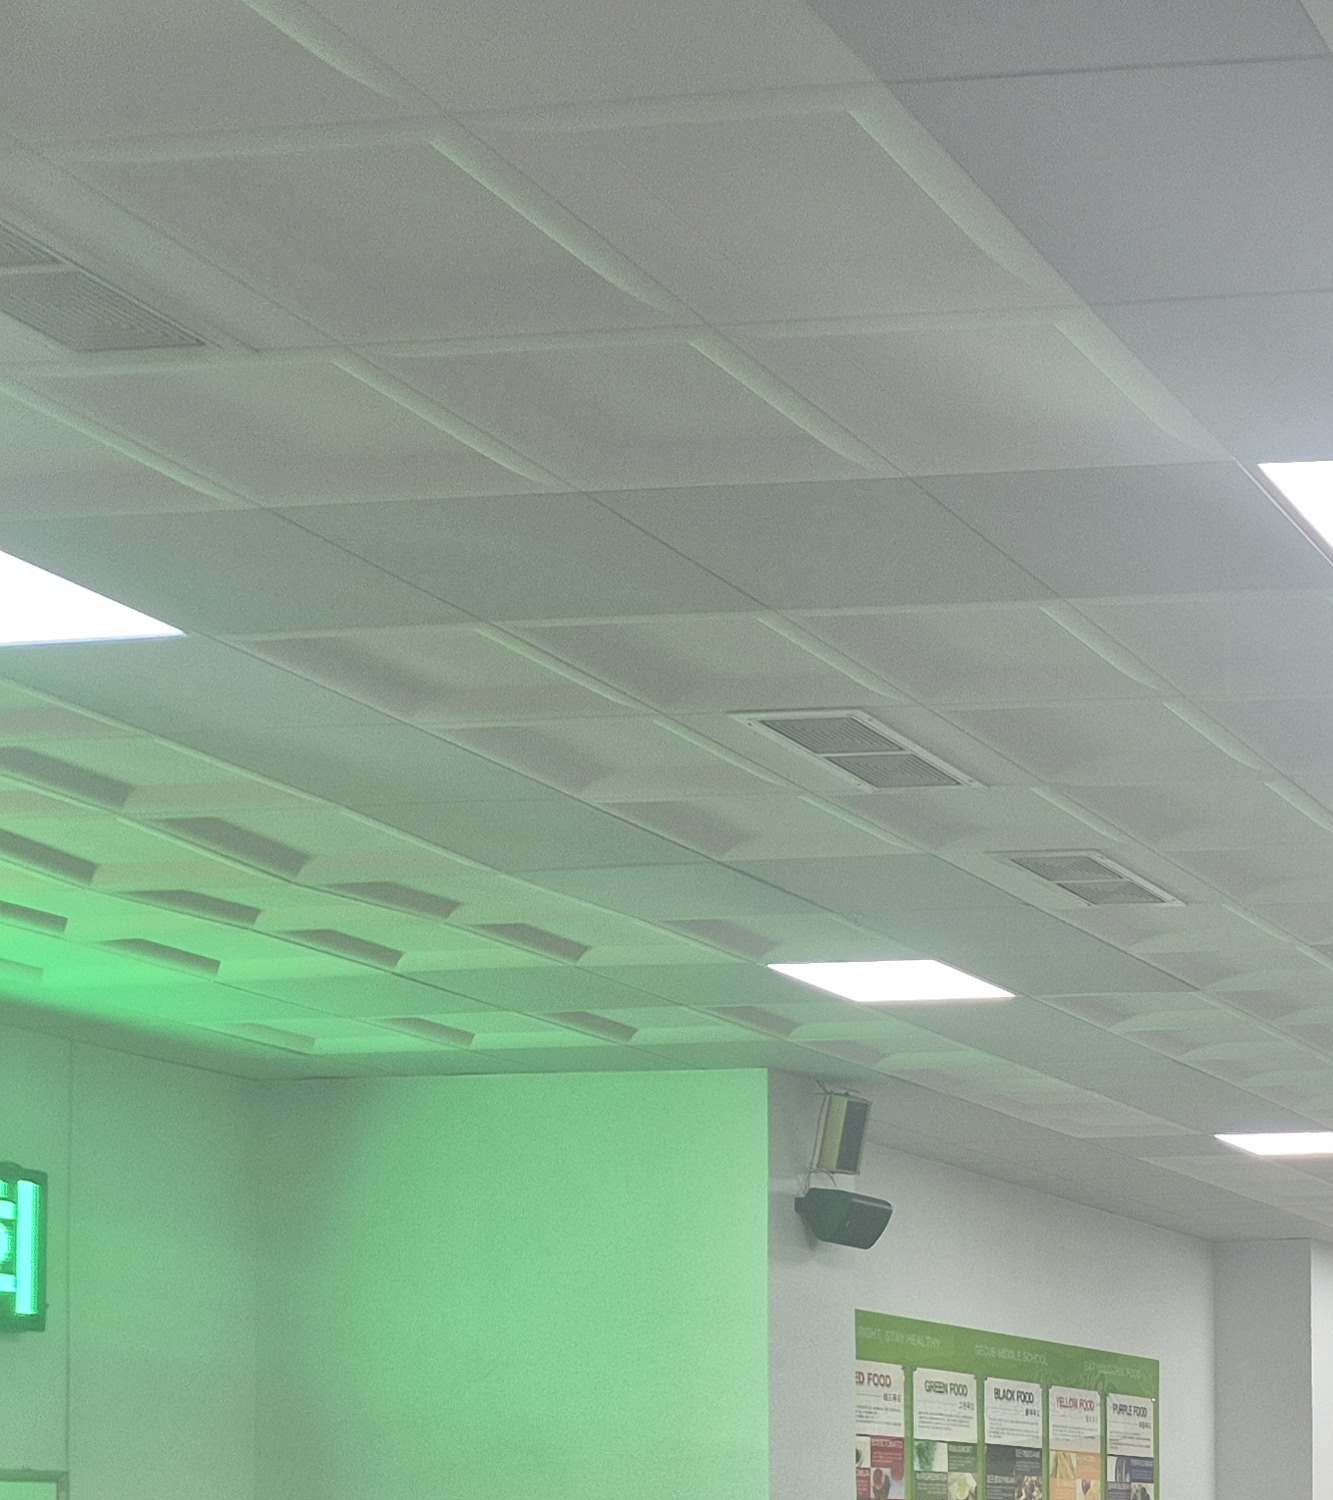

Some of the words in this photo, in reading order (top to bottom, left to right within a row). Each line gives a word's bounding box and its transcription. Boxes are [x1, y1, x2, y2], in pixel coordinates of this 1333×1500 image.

[906, 1334, 940, 1349] HEALTHY
[867, 1372, 892, 1388] FOOD
[924, 1379, 948, 1395] GREEN
[949, 1382, 968, 1397] FOOD
[993, 1387, 1015, 1403] BLACK
[1016, 1390, 1034, 1405] FOOD
[1055, 1396, 1078, 1410] YELLOW
[1079, 1398, 1095, 1412] FOOD
[1112, 1403, 1133, 1416] PURPLE
[1133, 1405, 1148, 1418] FOOD
